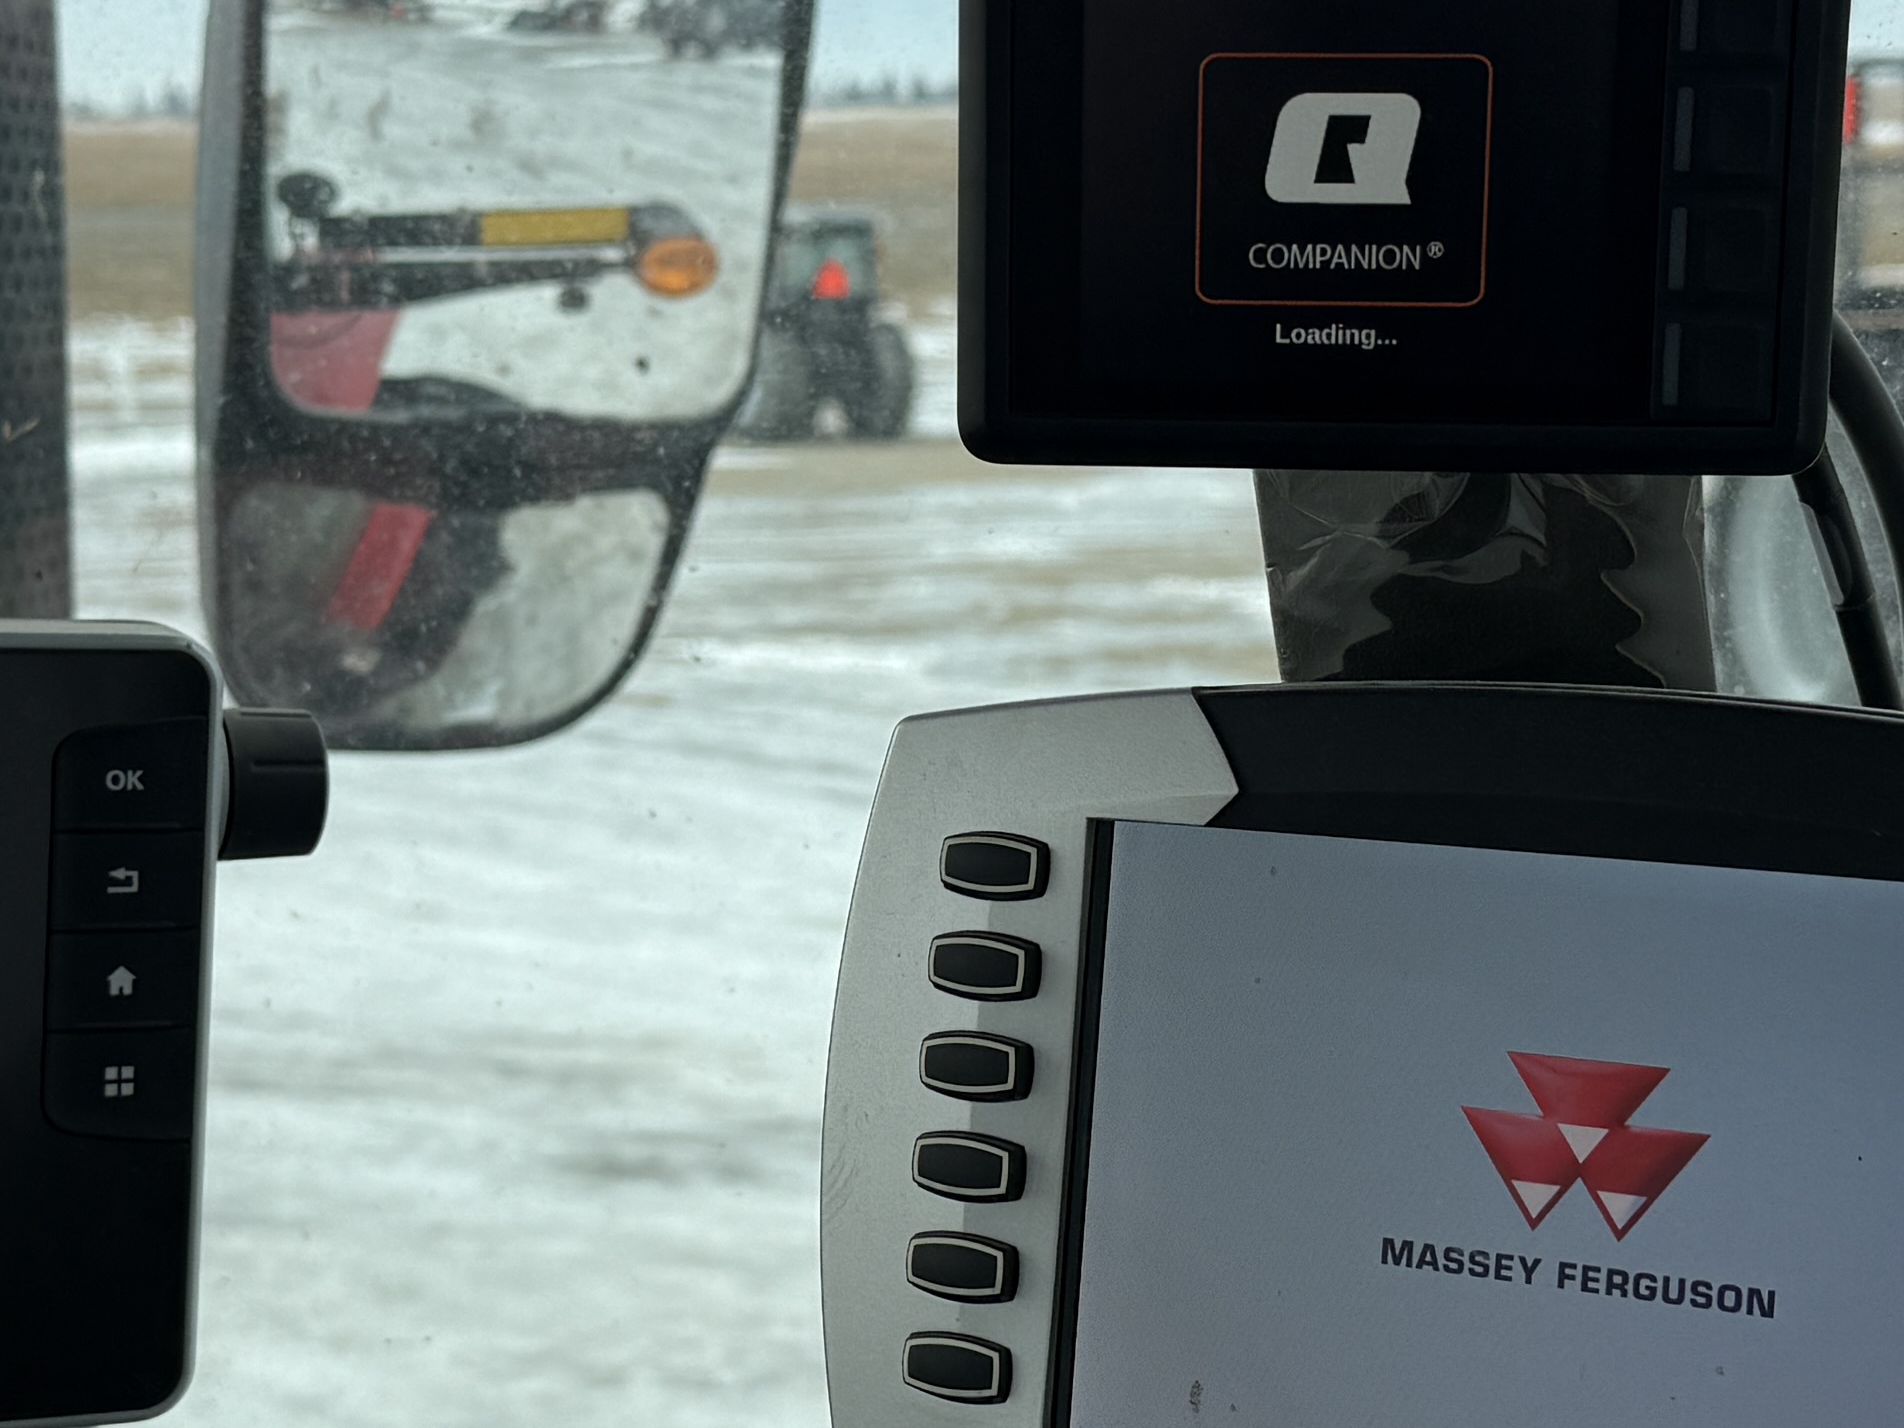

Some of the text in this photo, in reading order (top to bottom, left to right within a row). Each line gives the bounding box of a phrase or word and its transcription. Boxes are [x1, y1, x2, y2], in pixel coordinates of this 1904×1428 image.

[1274, 323, 1398, 350] Loading...
[105, 768, 145, 792] OK
[1379, 1236, 1777, 1320] MASSEY FERGUSON
